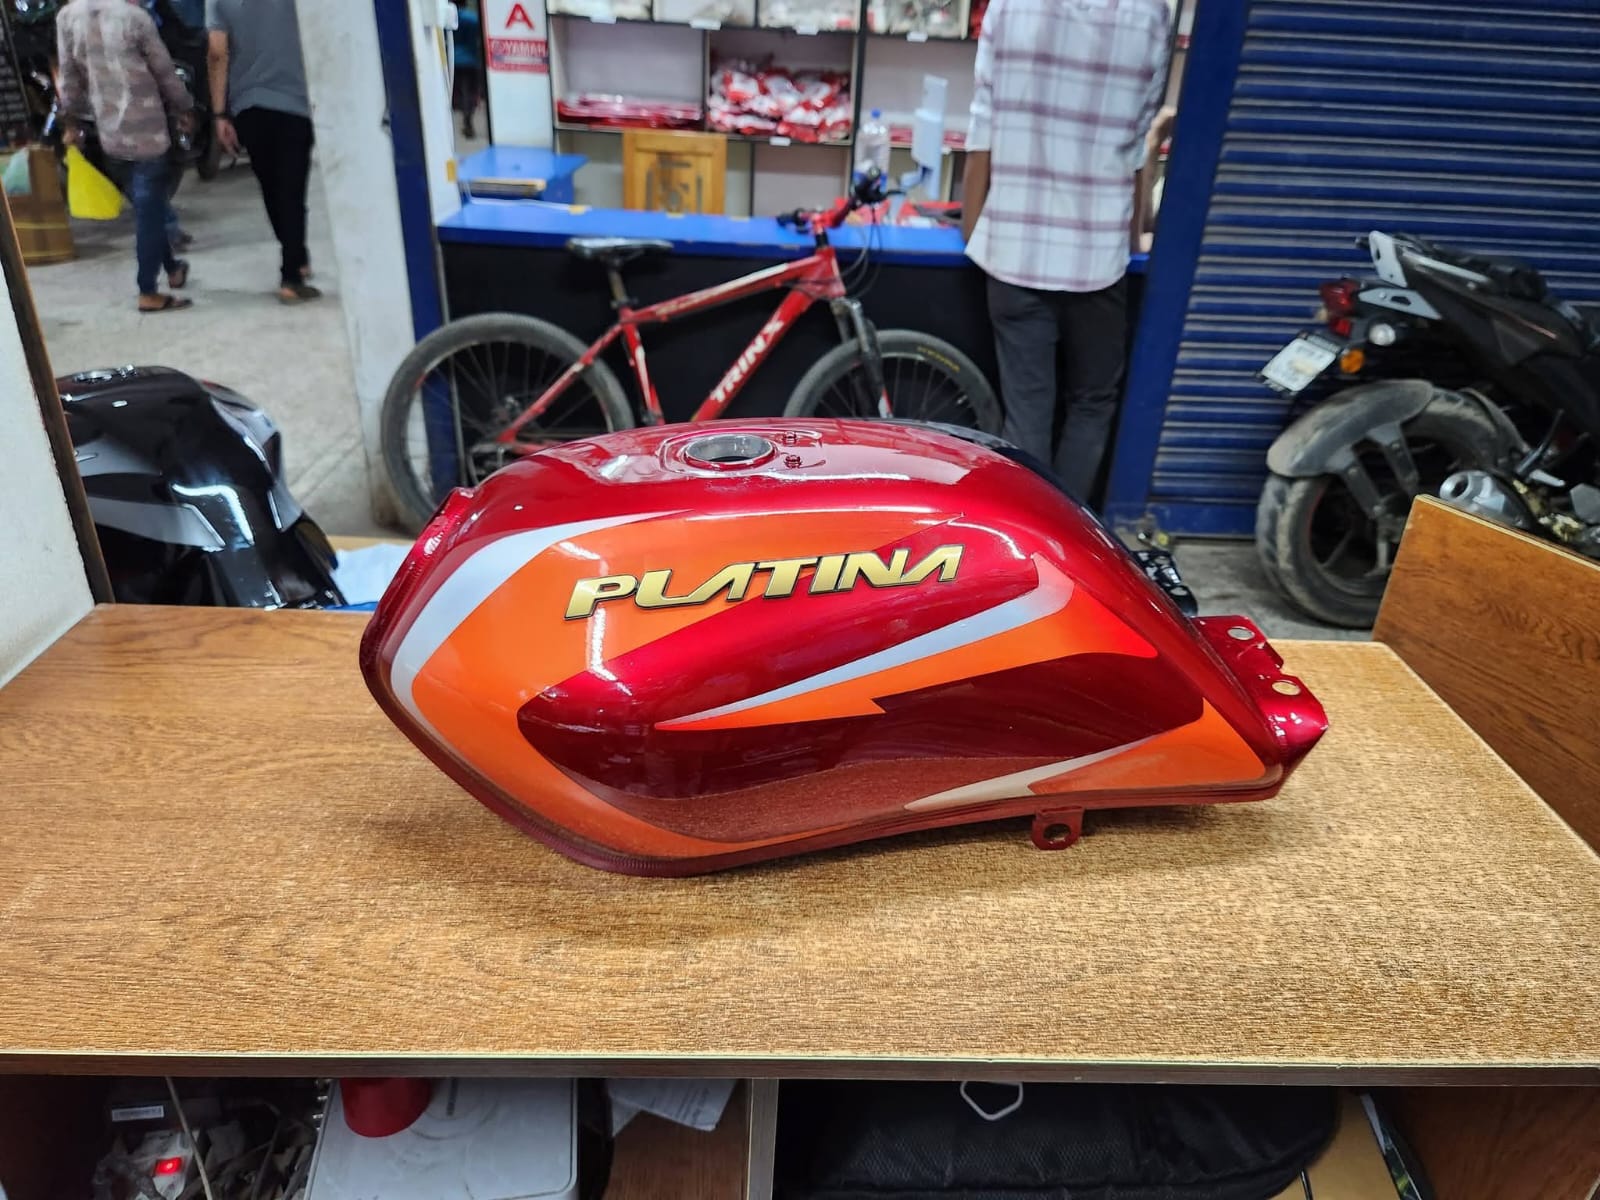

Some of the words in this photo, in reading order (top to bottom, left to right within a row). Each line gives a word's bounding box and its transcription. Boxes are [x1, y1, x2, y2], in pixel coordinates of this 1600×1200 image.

[505, 3, 535, 30] A
[710, 319, 784, 402] TRINX
[564, 544, 965, 620] PLATINA
